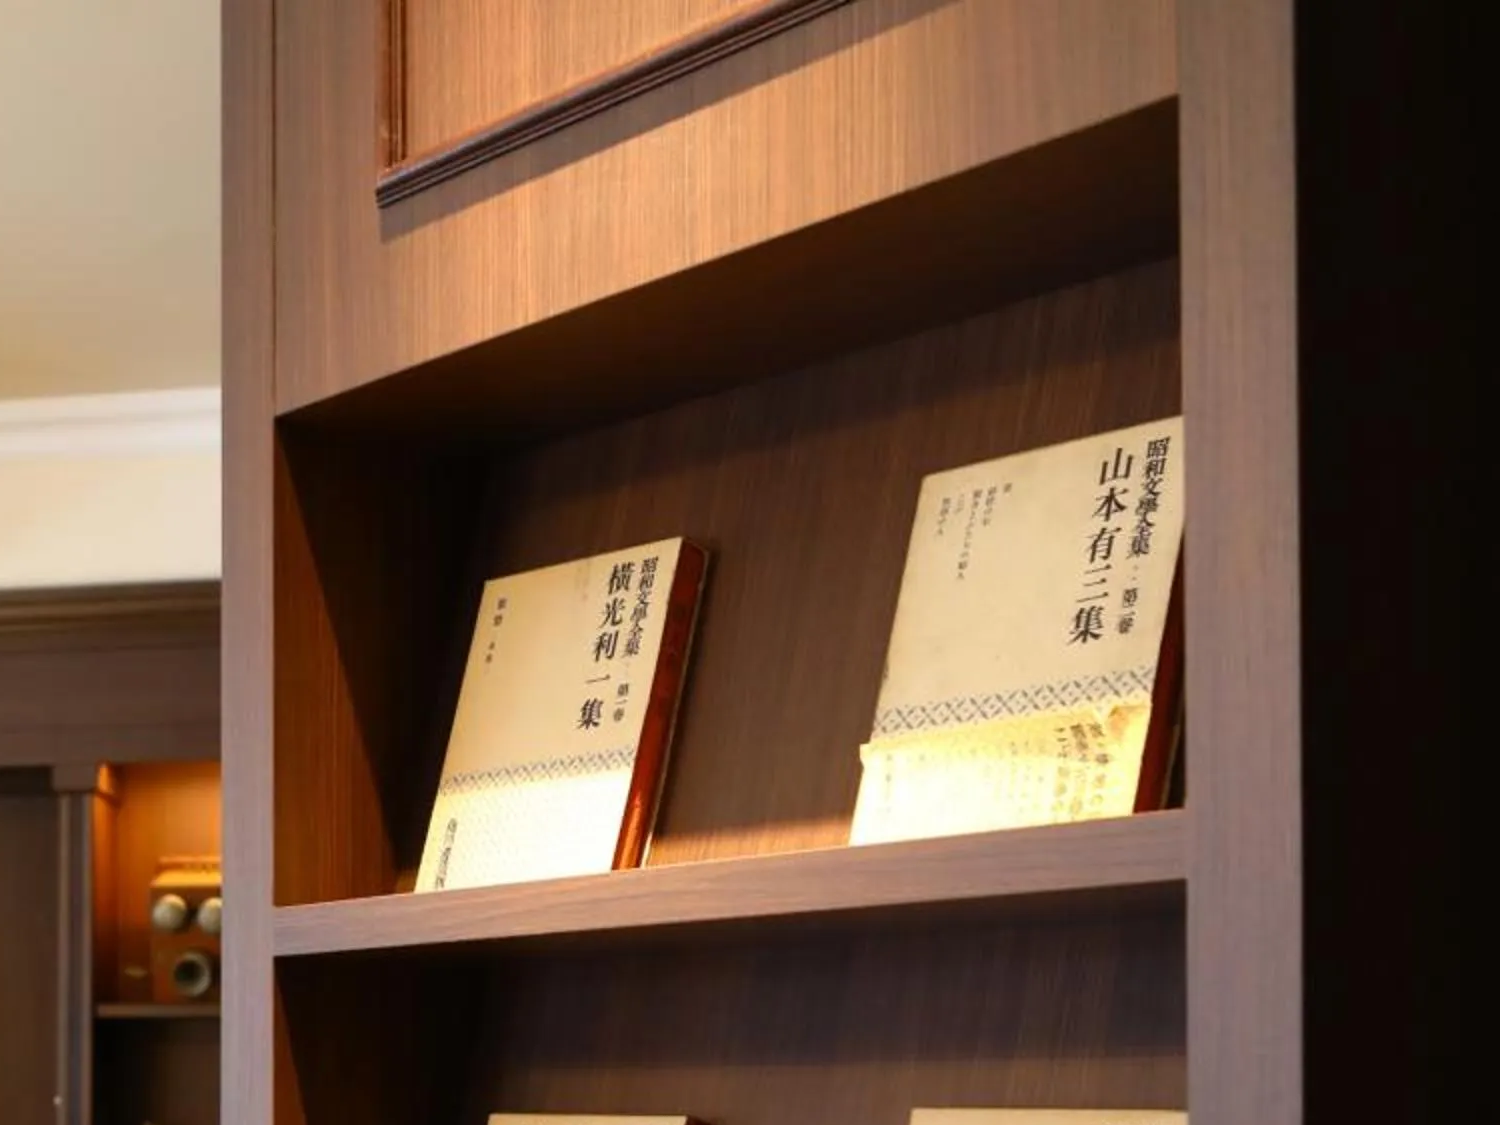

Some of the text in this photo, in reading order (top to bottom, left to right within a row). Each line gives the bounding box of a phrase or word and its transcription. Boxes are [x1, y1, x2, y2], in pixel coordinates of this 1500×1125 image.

[1067, 447, 1134, 646] 山本有三集
